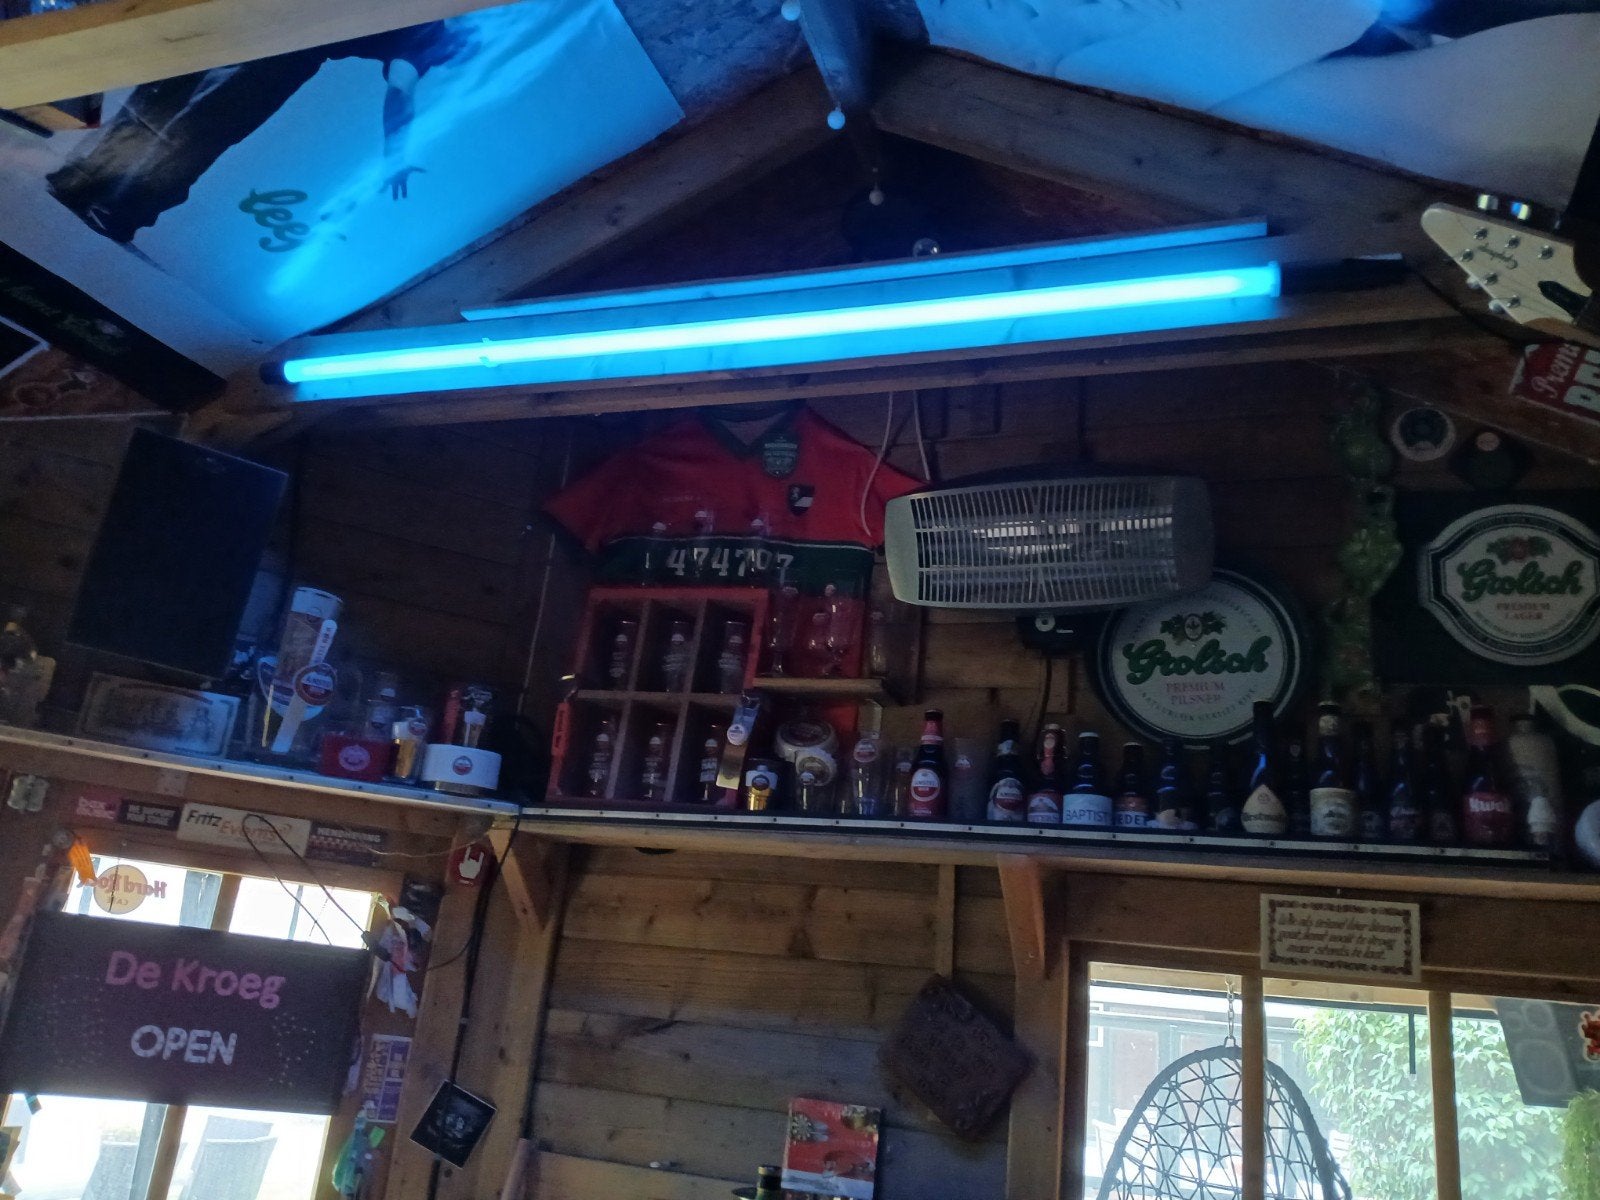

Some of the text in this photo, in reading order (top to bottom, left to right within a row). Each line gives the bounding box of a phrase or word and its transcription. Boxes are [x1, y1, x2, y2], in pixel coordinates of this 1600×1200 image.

[1457, 559, 1583, 602] Grolsch
[1122, 636, 1273, 685] Grolsch
[1167, 681, 1225, 692] PREMIUM
[186, 810, 222, 828] Fritz
[105, 950, 286, 1009] De Kroeg
[131, 1024, 237, 1065] OPEN
